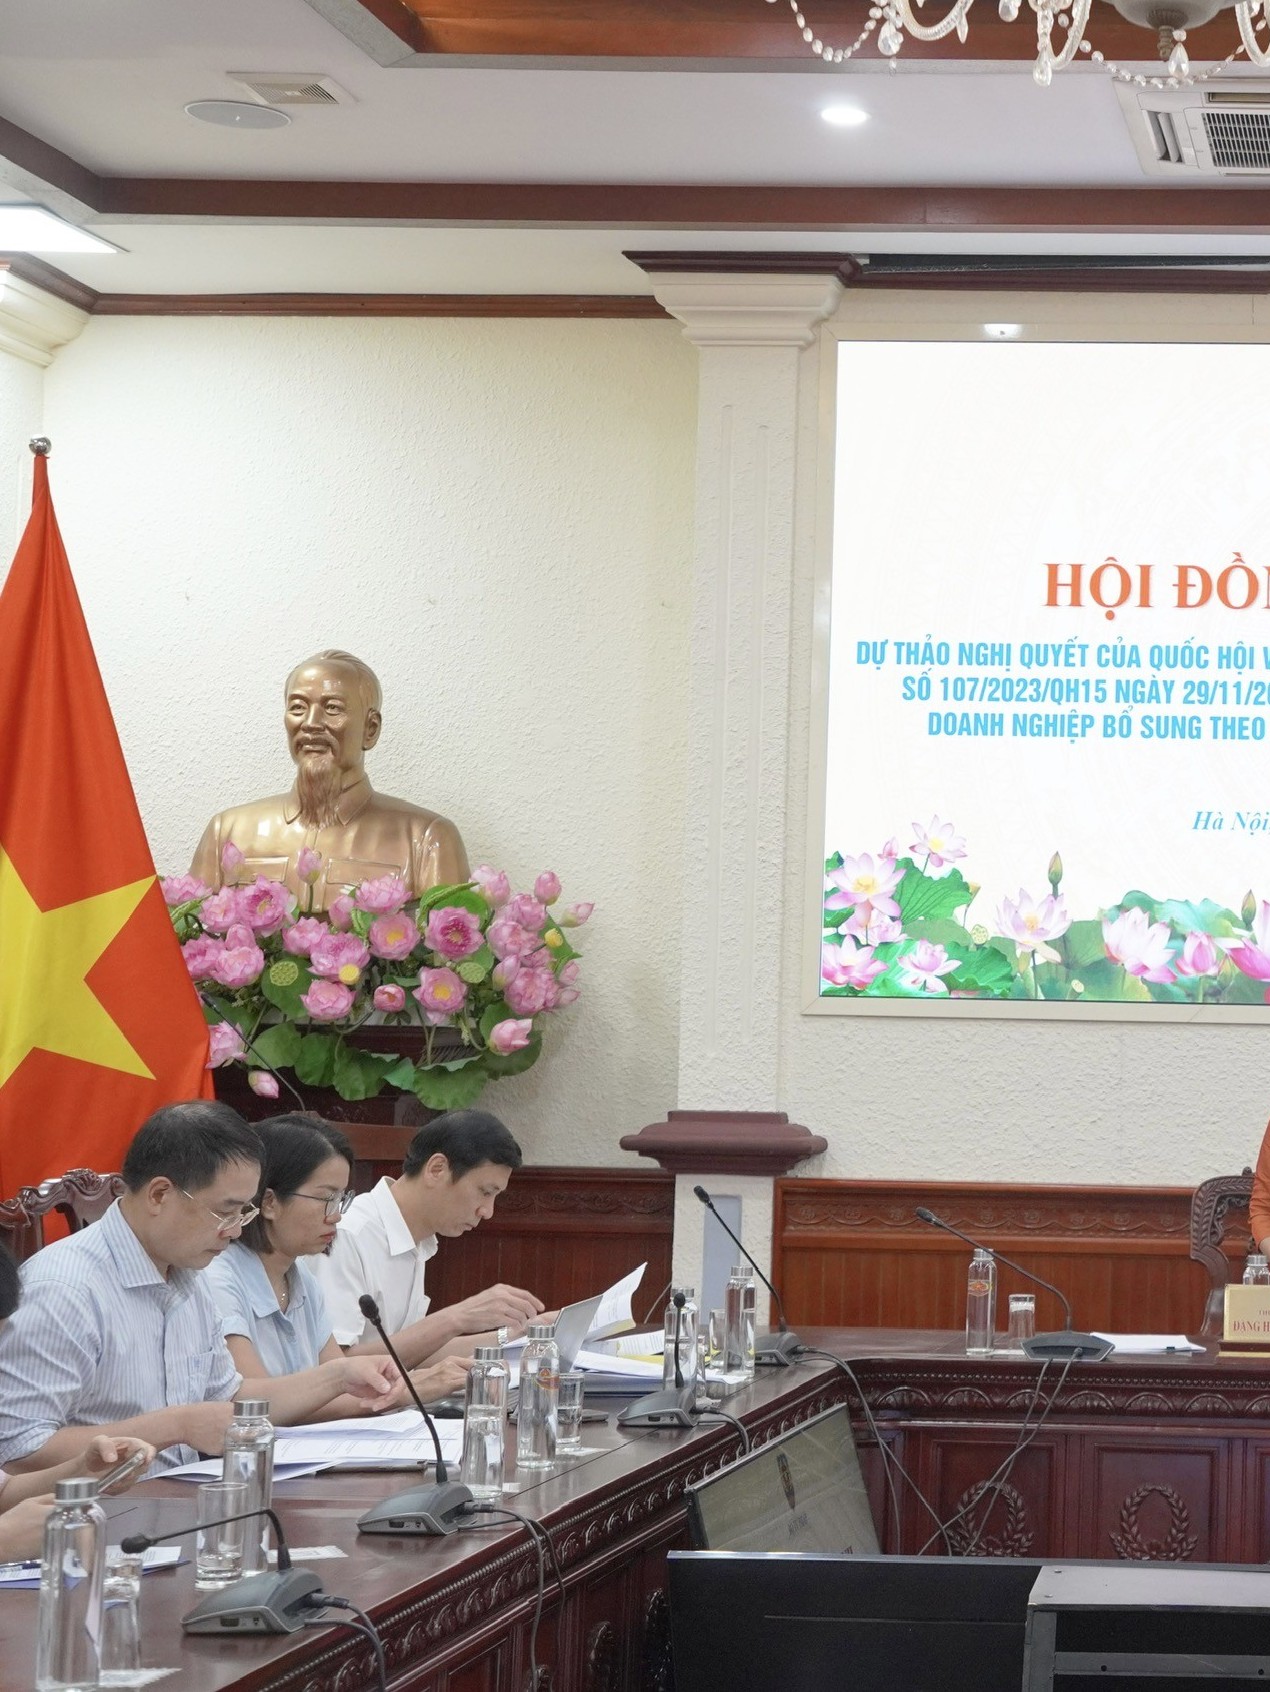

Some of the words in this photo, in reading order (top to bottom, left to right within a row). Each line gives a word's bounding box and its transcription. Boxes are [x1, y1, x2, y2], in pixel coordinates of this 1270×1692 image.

[1043, 556, 1154, 620] HỘI
[856, 639, 888, 670] DỰ
[894, 634, 950, 666] THẢO
[959, 642, 1012, 672] NGHỊ
[1020, 636, 1089, 669] QUYẾT
[1097, 636, 1141, 668] CỦA
[1150, 636, 1209, 671] QUỐC
[1218, 640, 1254, 675] HỘI
[902, 668, 932, 701] SỐ
[940, 676, 1107, 705] 107/2023/QH15
[1115, 675, 1175, 704] NGÀY
[928, 712, 1004, 737] DOANH
[1012, 709, 1095, 744] NGHIỆP
[1102, 705, 1133, 739] BỔ
[1140, 715, 1202, 740] SUNG
[1210, 716, 1265, 740] THEO
[1192, 811, 1223, 831] Hà
